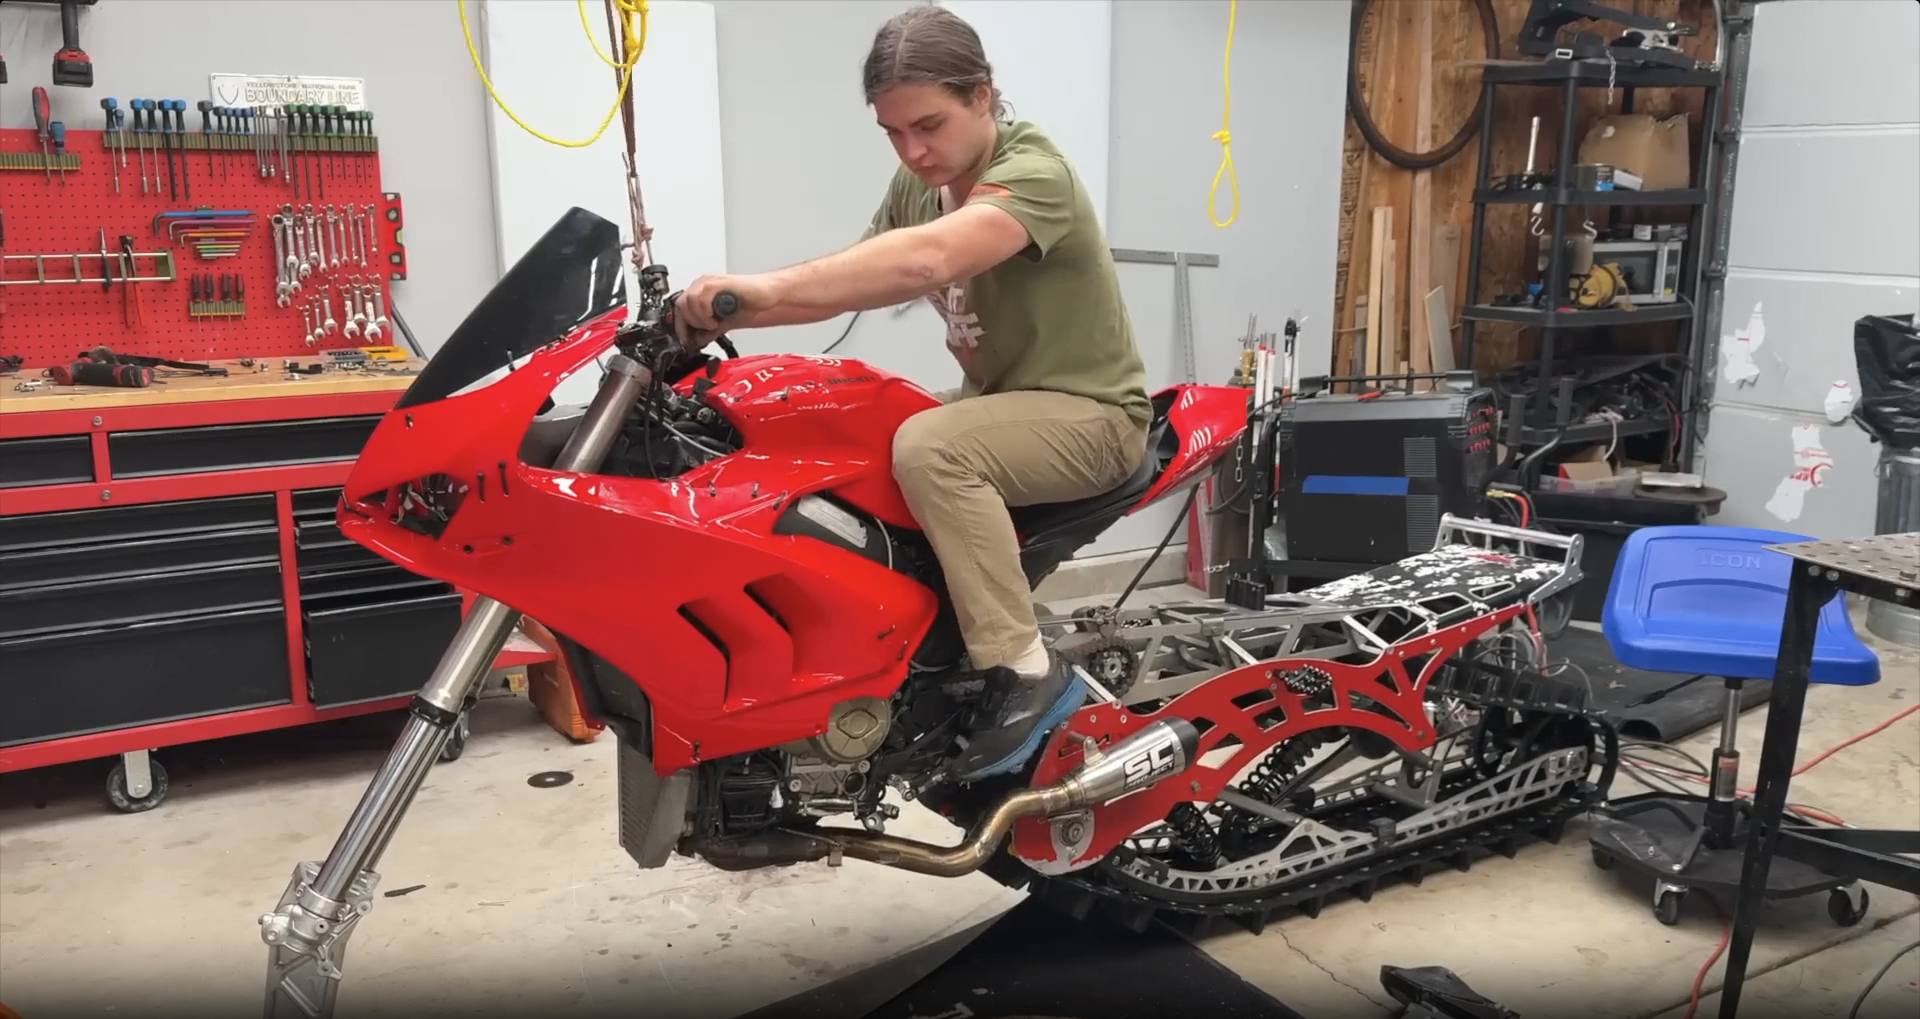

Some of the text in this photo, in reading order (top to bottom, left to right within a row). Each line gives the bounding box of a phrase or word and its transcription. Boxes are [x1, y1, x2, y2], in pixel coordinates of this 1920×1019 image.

[245, 88, 360, 105] BOUNDARY LINE
[1700, 553, 1761, 569] ICON
[1124, 740, 1175, 785] SC
